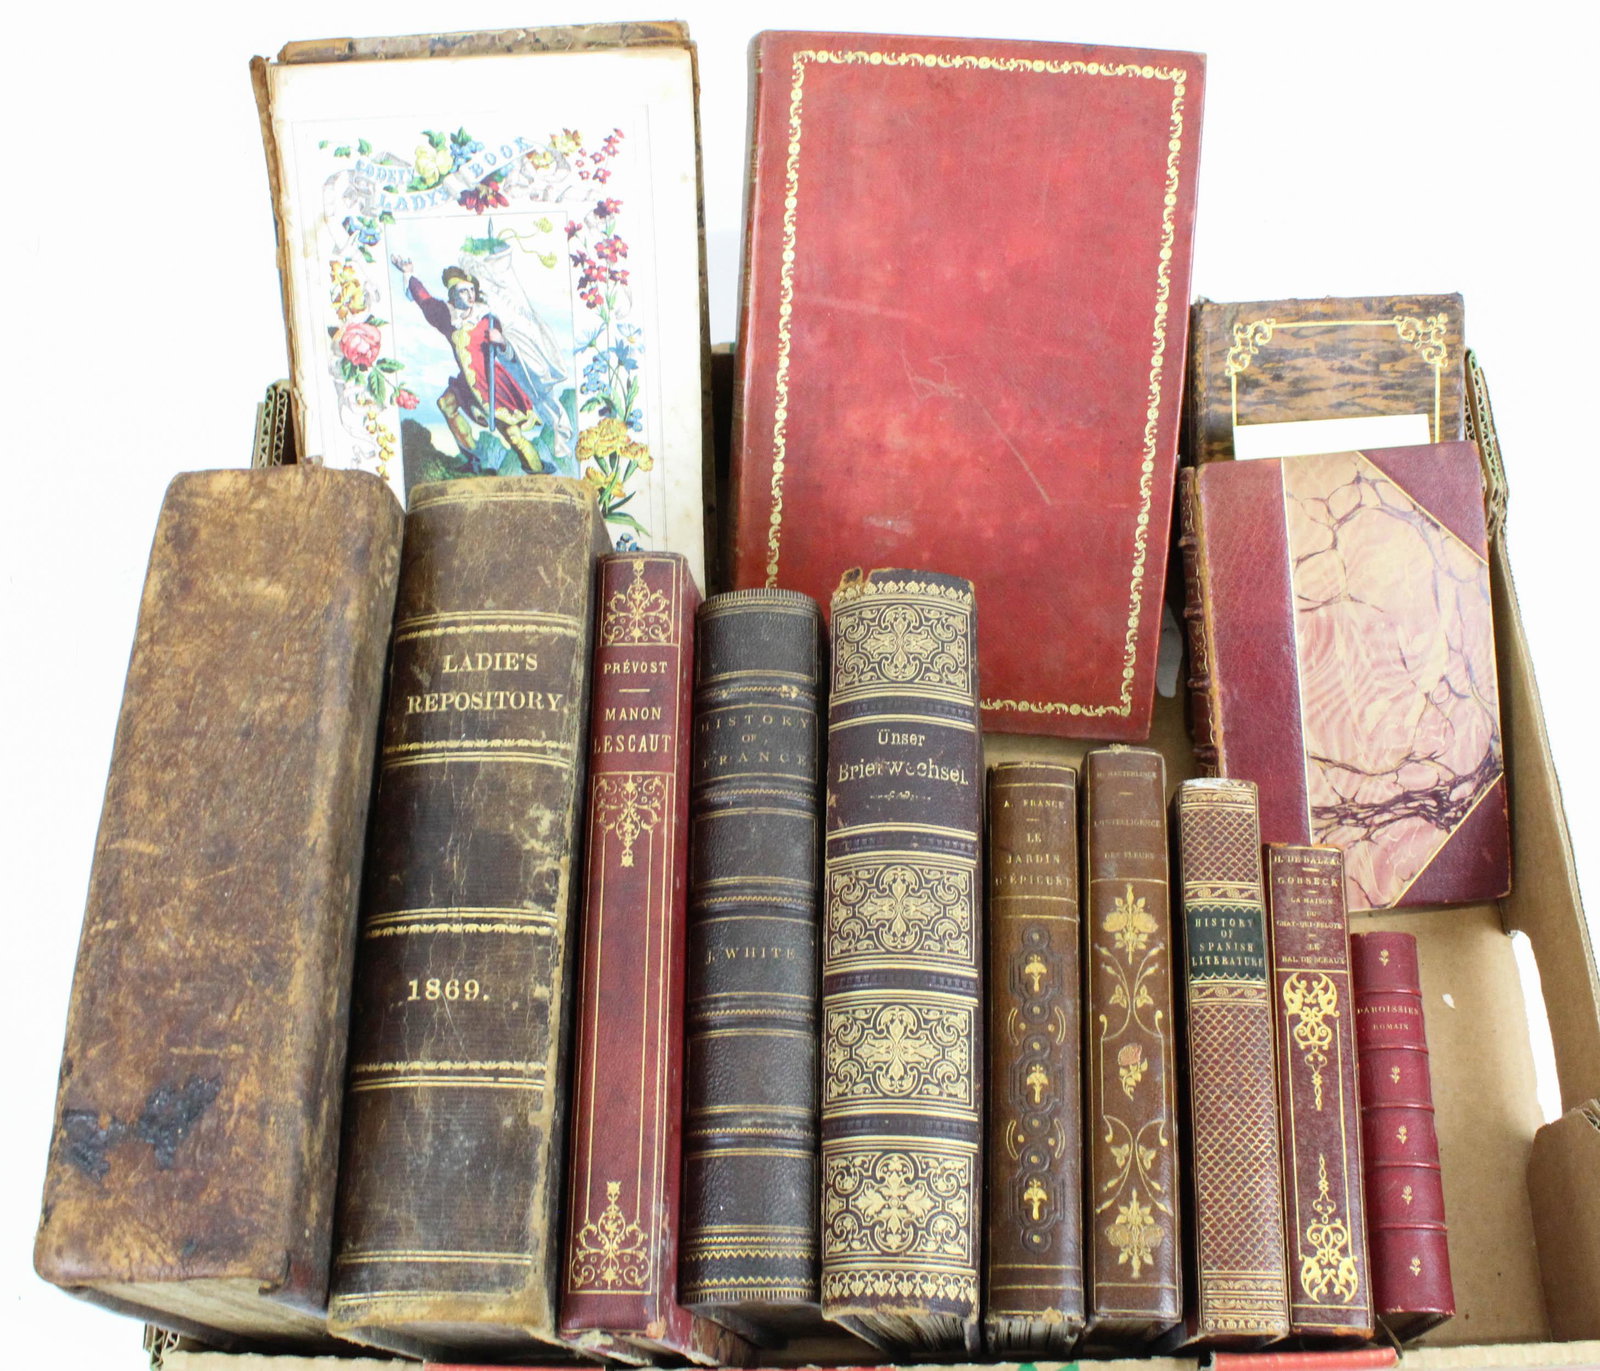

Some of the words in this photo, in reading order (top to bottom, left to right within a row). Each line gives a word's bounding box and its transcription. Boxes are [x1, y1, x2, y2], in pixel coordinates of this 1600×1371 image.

[470, 136, 535, 178] BOOK
[442, 652, 539, 674] LADIE'S
[603, 658, 668, 674] PRÉVOST
[605, 706, 662, 721] MANON
[701, 714, 809, 733] HISTORY
[593, 733, 672, 754] LESCAUT
[741, 734, 757, 743] OF
[703, 751, 808, 769] FRANCE
[1023, 799, 1065, 809] FRANCE
[1026, 833, 1042, 843] LE
[1006, 852, 1060, 865] JARDIN
[1287, 855, 1301, 864] DE
[1277, 876, 1338, 887] GOBSECK
[1303, 897, 1333, 905] MAISON
[1194, 917, 1255, 928] HISTORY
[1220, 929, 1233, 939] OF
[724, 946, 796, 960] WHITE
[1199, 942, 1255, 953] SPANISH
[1191, 955, 1264, 968] LITERATURE
[406, 978, 490, 1001] 1869.
